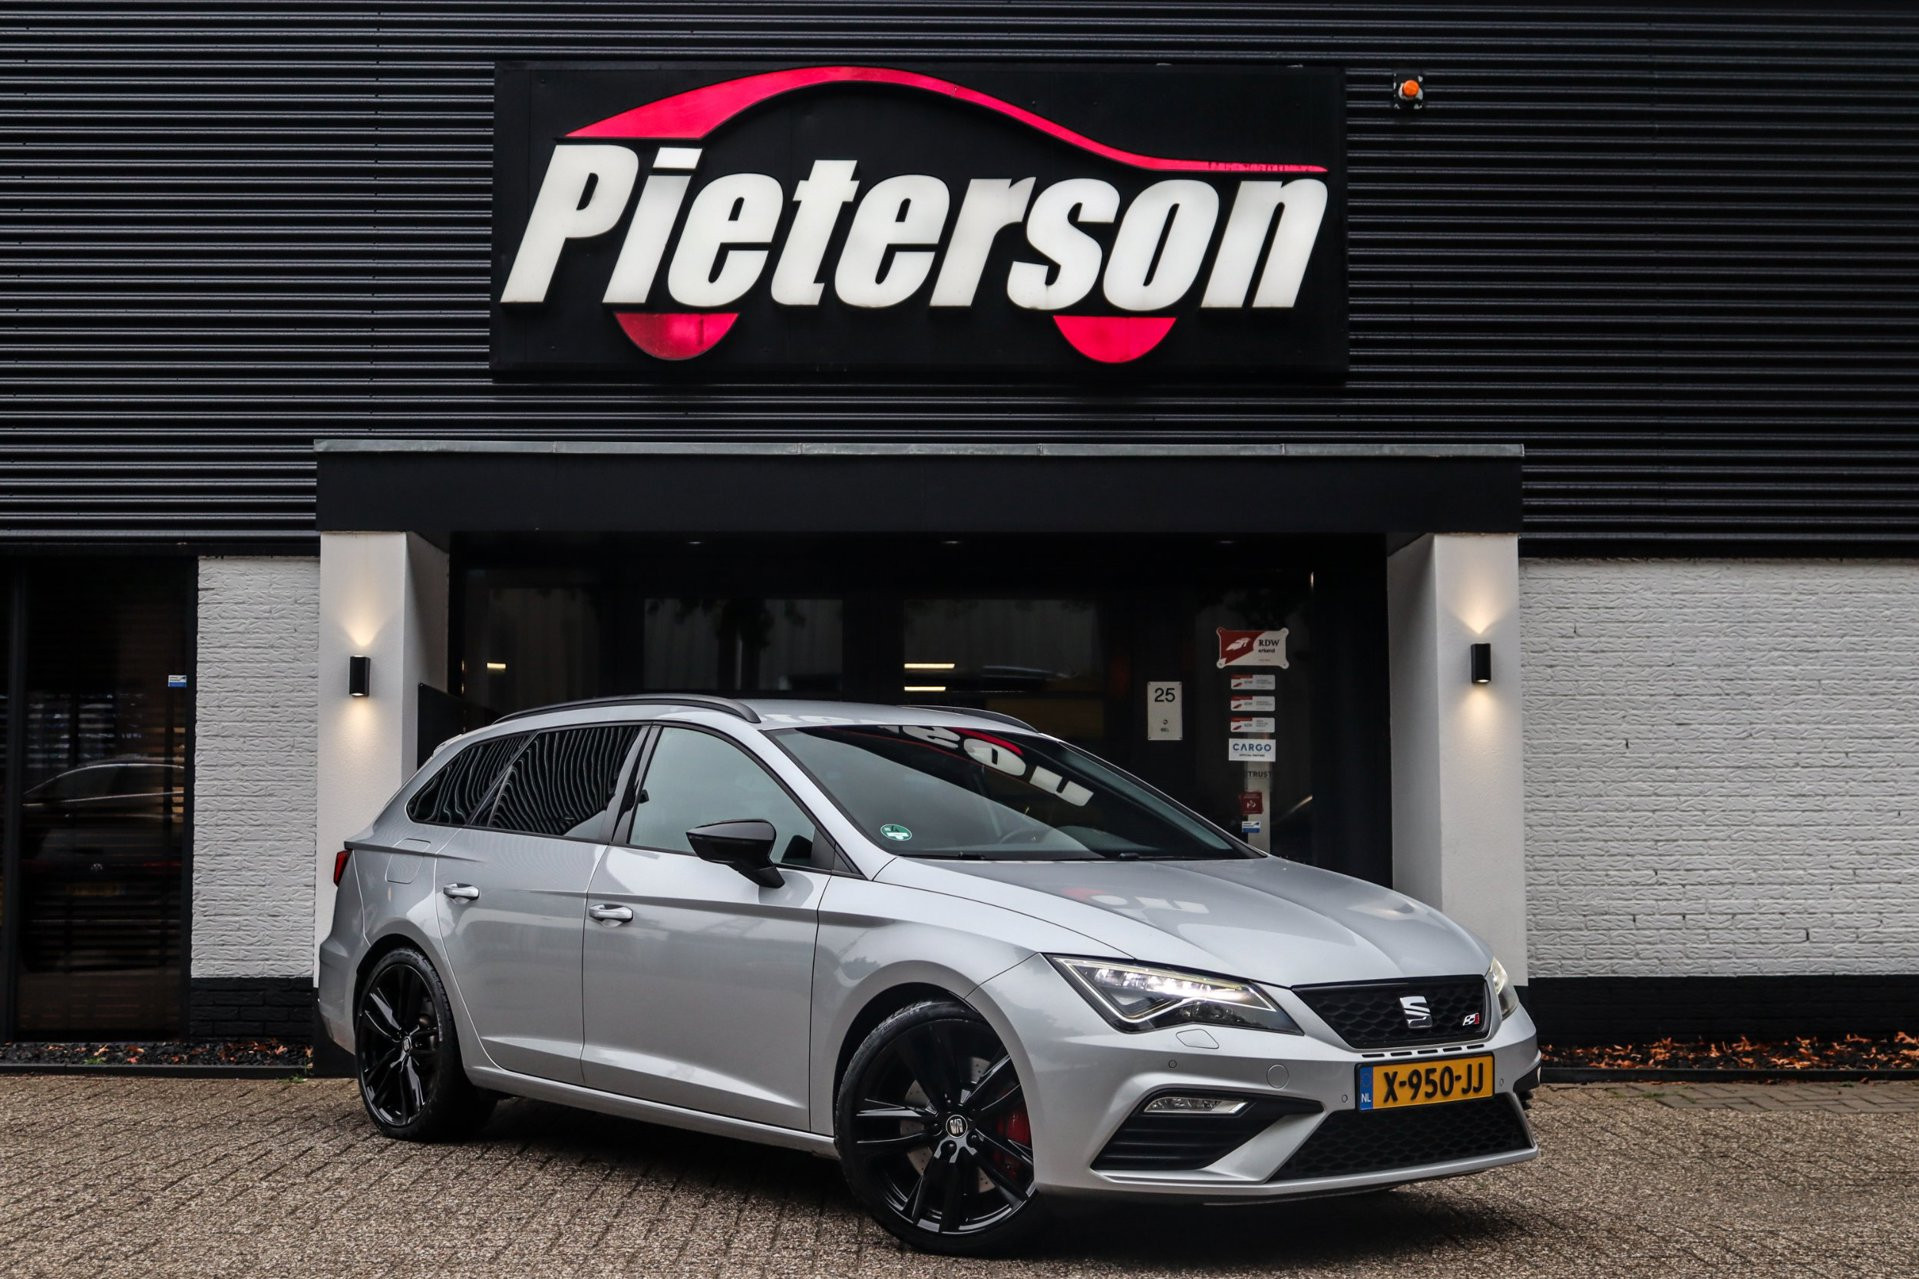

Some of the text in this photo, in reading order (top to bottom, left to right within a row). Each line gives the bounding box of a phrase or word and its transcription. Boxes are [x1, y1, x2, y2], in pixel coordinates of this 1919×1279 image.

[500, 144, 1330, 311] Pieterson
[1258, 639, 1280, 647] RDW
[1155, 688, 1175, 702] 25
[1232, 743, 1272, 752] CARGO
[1383, 1063, 1484, 1104] X-950-JJ
[1360, 1093, 1372, 1103] NL
